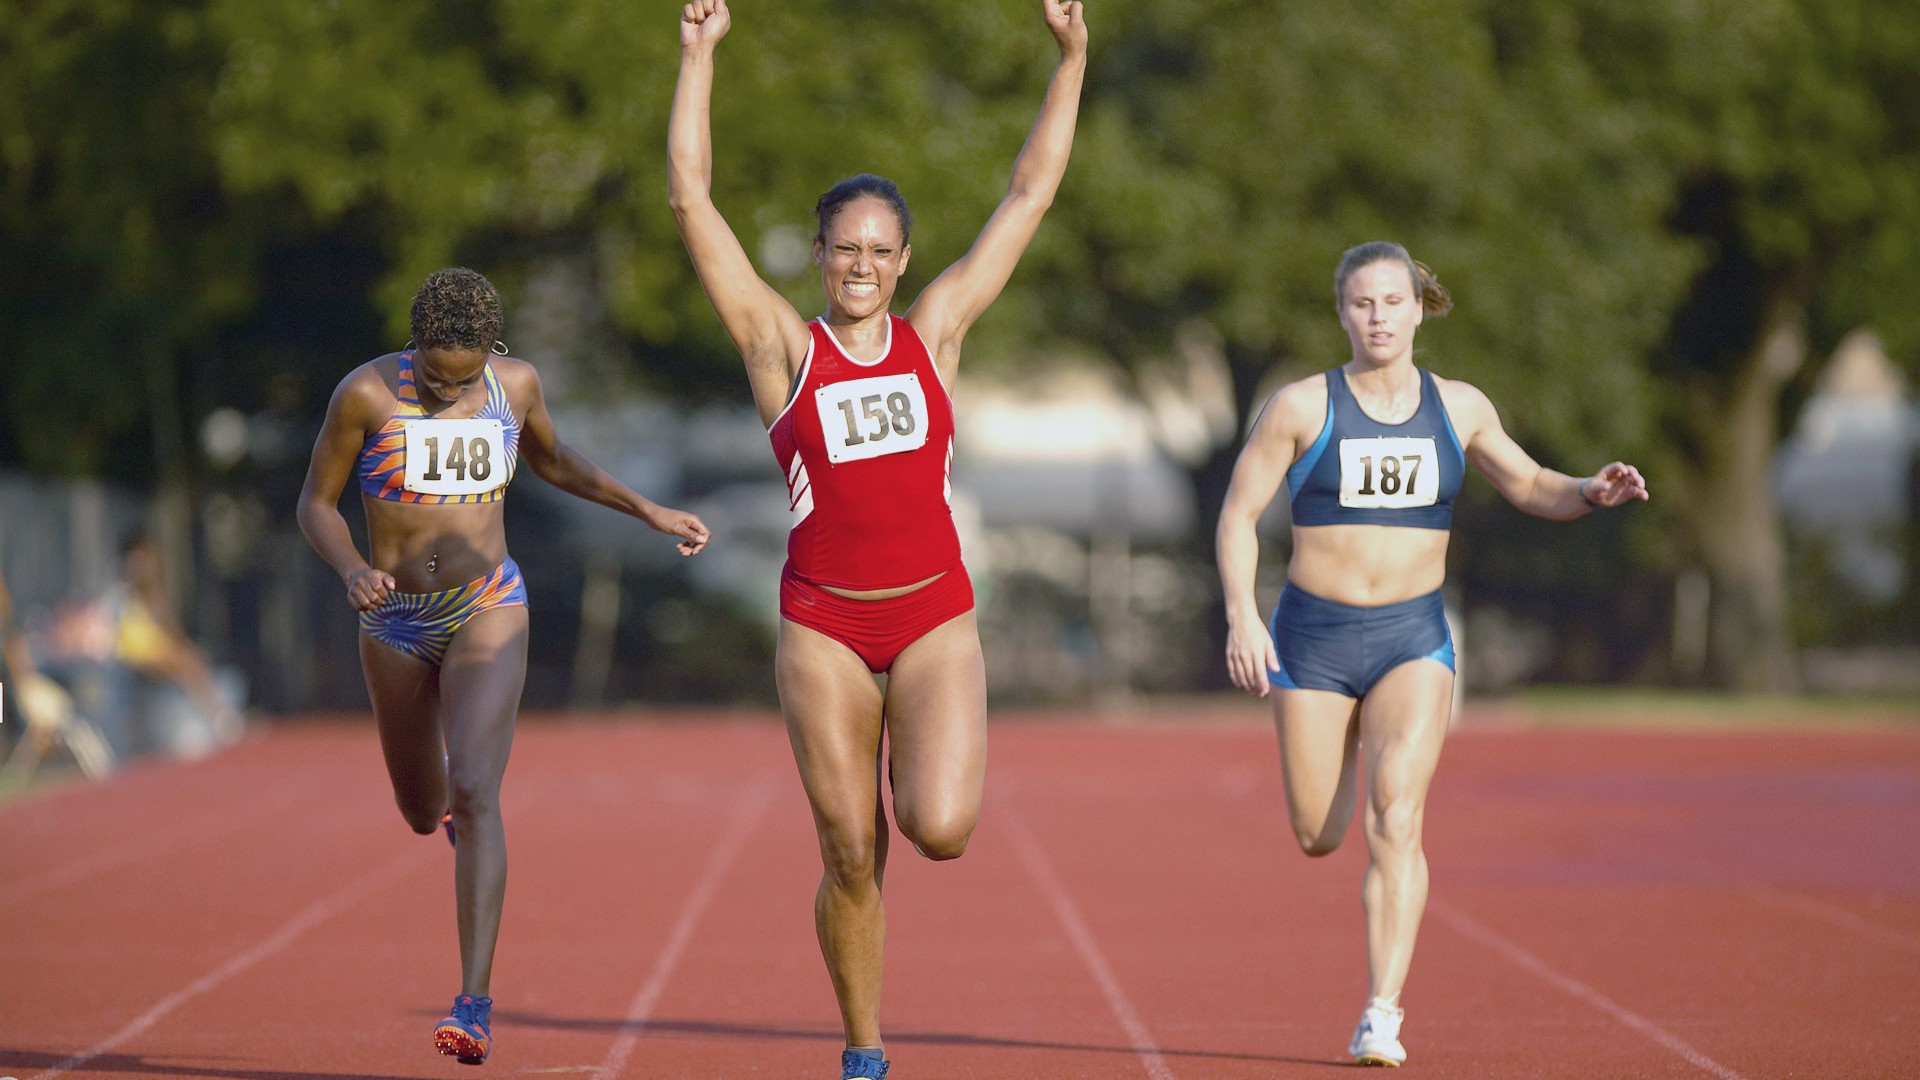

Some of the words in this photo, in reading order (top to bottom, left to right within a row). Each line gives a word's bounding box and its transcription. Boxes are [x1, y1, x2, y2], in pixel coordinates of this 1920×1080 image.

[837, 391, 916, 447] 158
[422, 436, 491, 482] 148
[1357, 454, 1422, 496] 187
